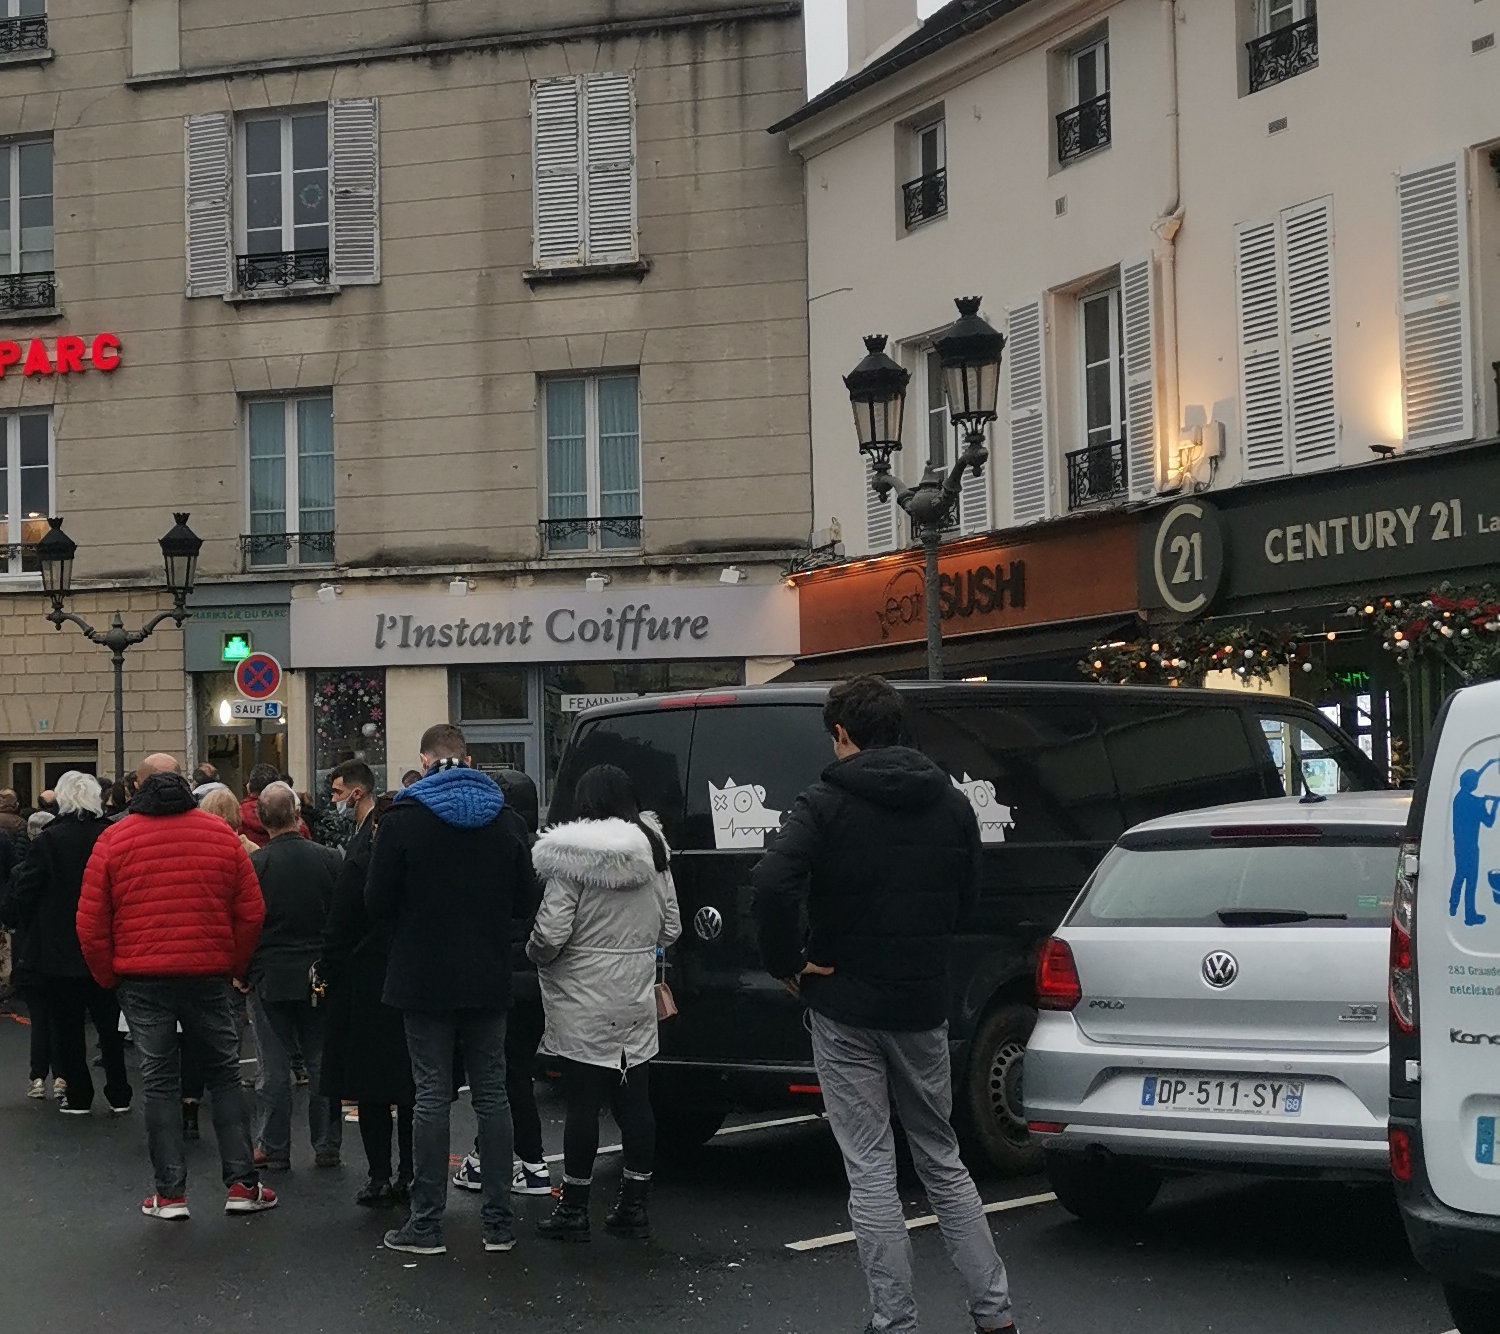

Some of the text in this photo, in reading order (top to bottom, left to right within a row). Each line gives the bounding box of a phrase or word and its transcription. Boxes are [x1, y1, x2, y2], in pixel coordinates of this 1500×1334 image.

[1264, 505, 1422, 565] CENTURY
[1429, 498, 1463, 542] 21
[938, 559, 1027, 620] SUSHI
[244, 609, 259, 619] DU
[545, 603, 710, 651] Coiffure
[234, 704, 263, 714] SAUF
[1158, 1079, 1284, 1109] DP-511-SY
